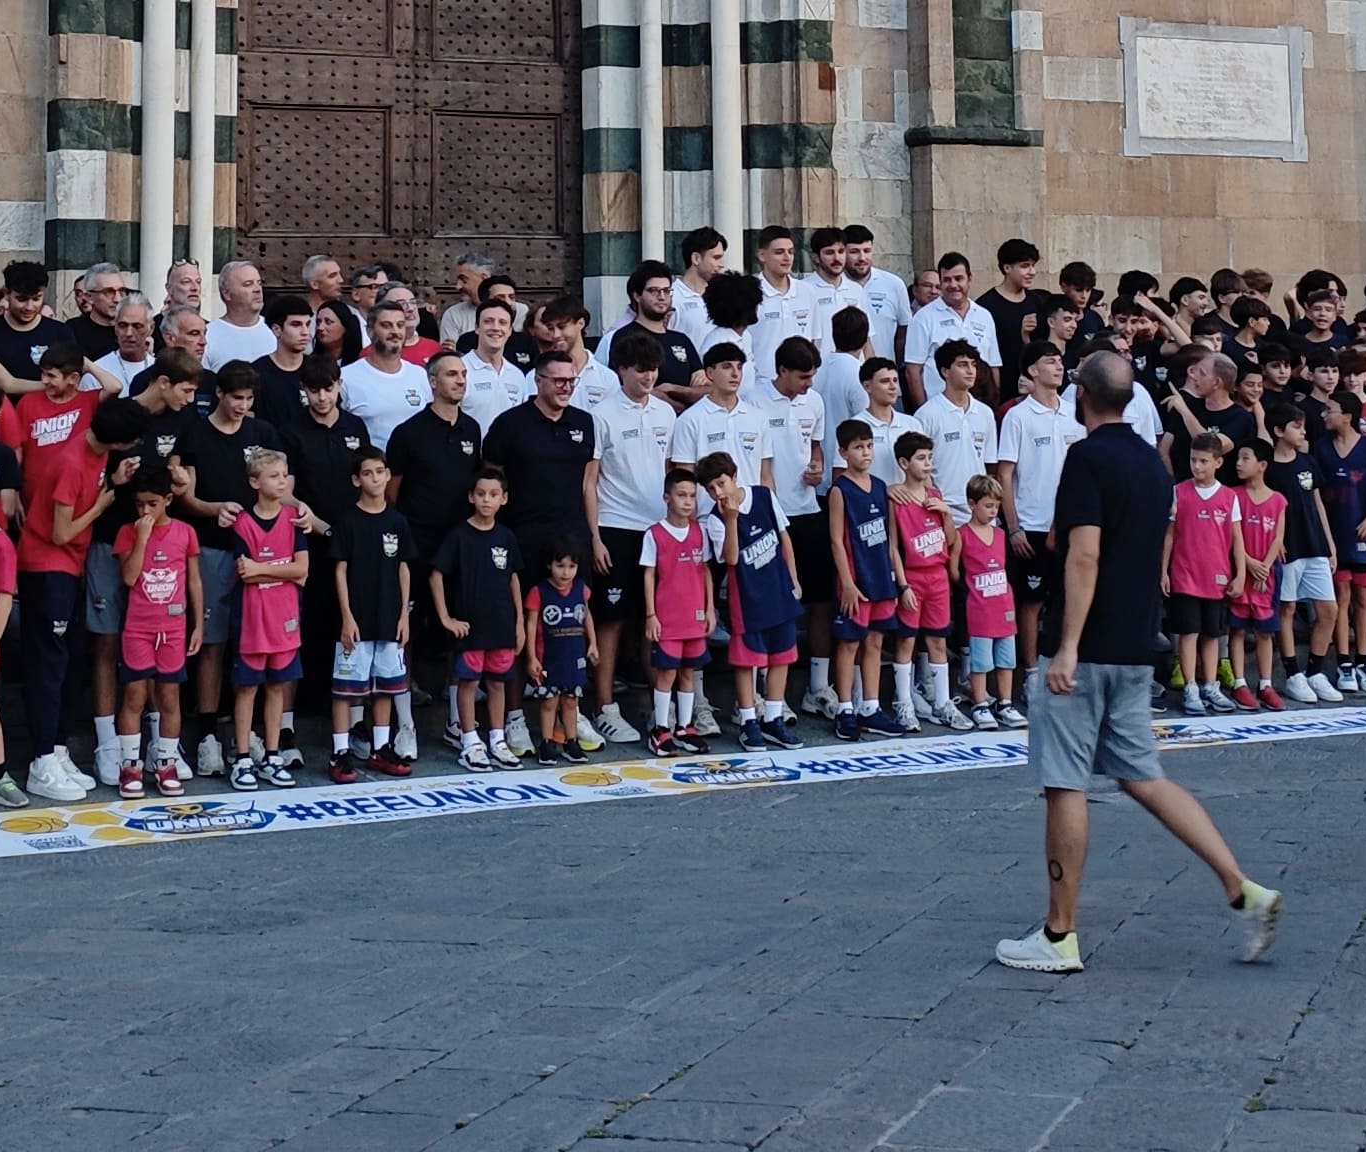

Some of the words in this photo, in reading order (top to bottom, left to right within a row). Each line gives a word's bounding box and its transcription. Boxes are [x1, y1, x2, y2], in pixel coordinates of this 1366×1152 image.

[31, 409, 81, 437] UNION
[858, 519, 886, 541] UNIO
[742, 529, 779, 565] UNION
[975, 570, 1006, 589] UNIO
[796, 743, 1029, 776] #BEEUNION
[276, 783, 571, 822] #BEEUNION
[145, 812, 264, 832] UNION
